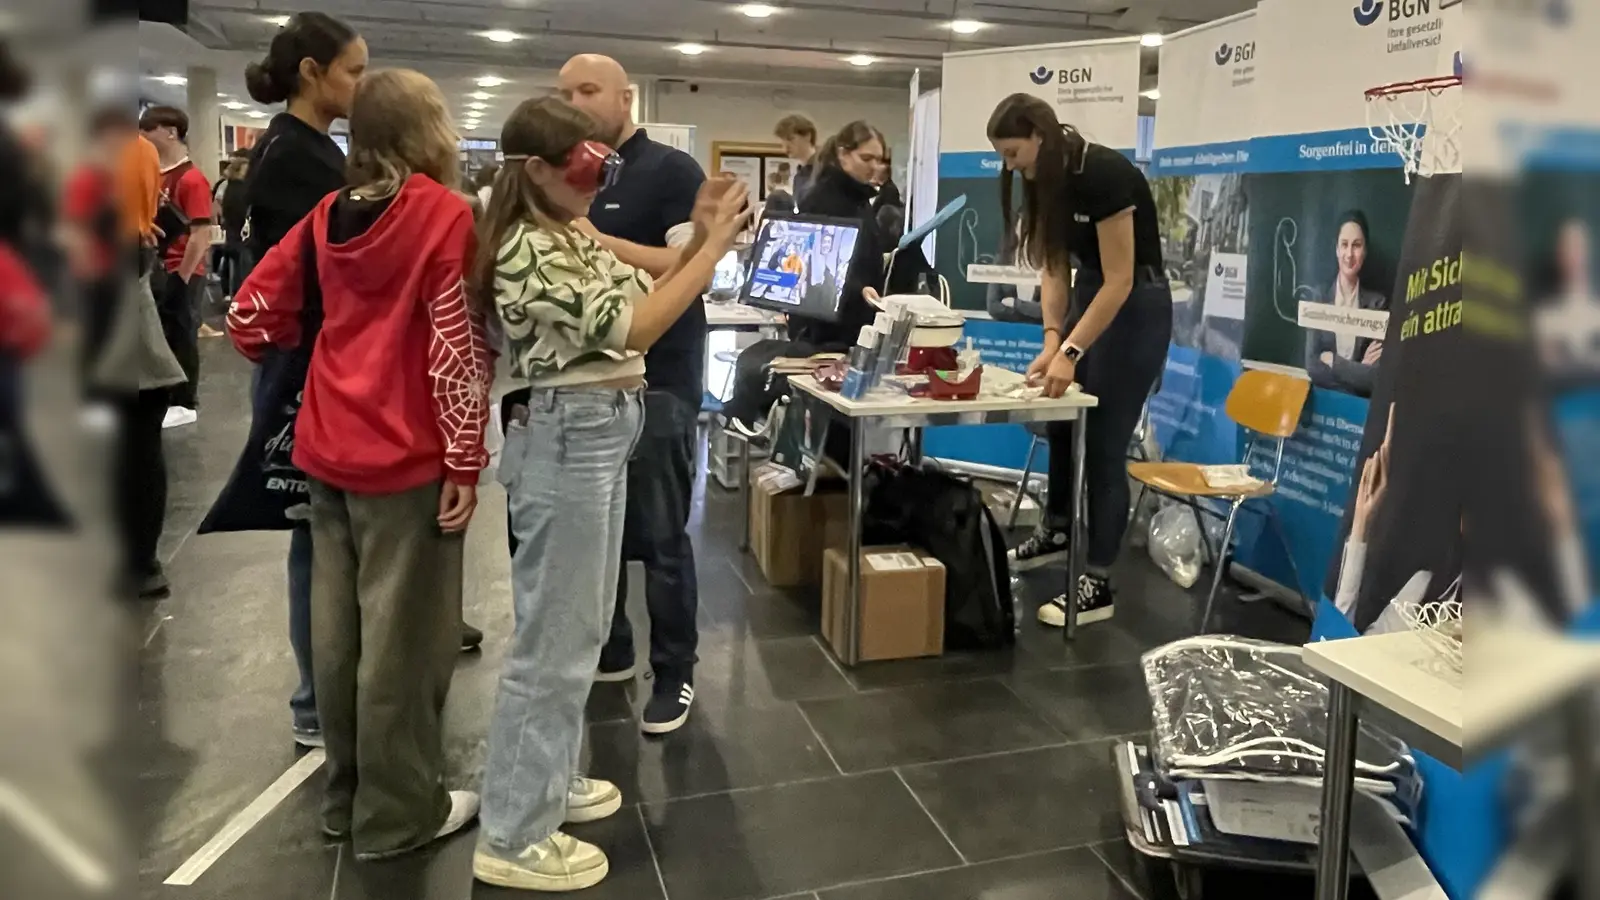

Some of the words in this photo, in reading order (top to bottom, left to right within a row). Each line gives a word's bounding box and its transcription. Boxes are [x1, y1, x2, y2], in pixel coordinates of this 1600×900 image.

[1388, 0, 1431, 21] BGN
[1406, 18, 1443, 37] gesetzli
[1058, 66, 1092, 84] BGN
[1299, 140, 1353, 160] Sorgenfrei
[1355, 140, 1367, 155] in
[1405, 268, 1428, 304] Mit
[1400, 309, 1419, 341] ein
[1423, 300, 1463, 334] attra
